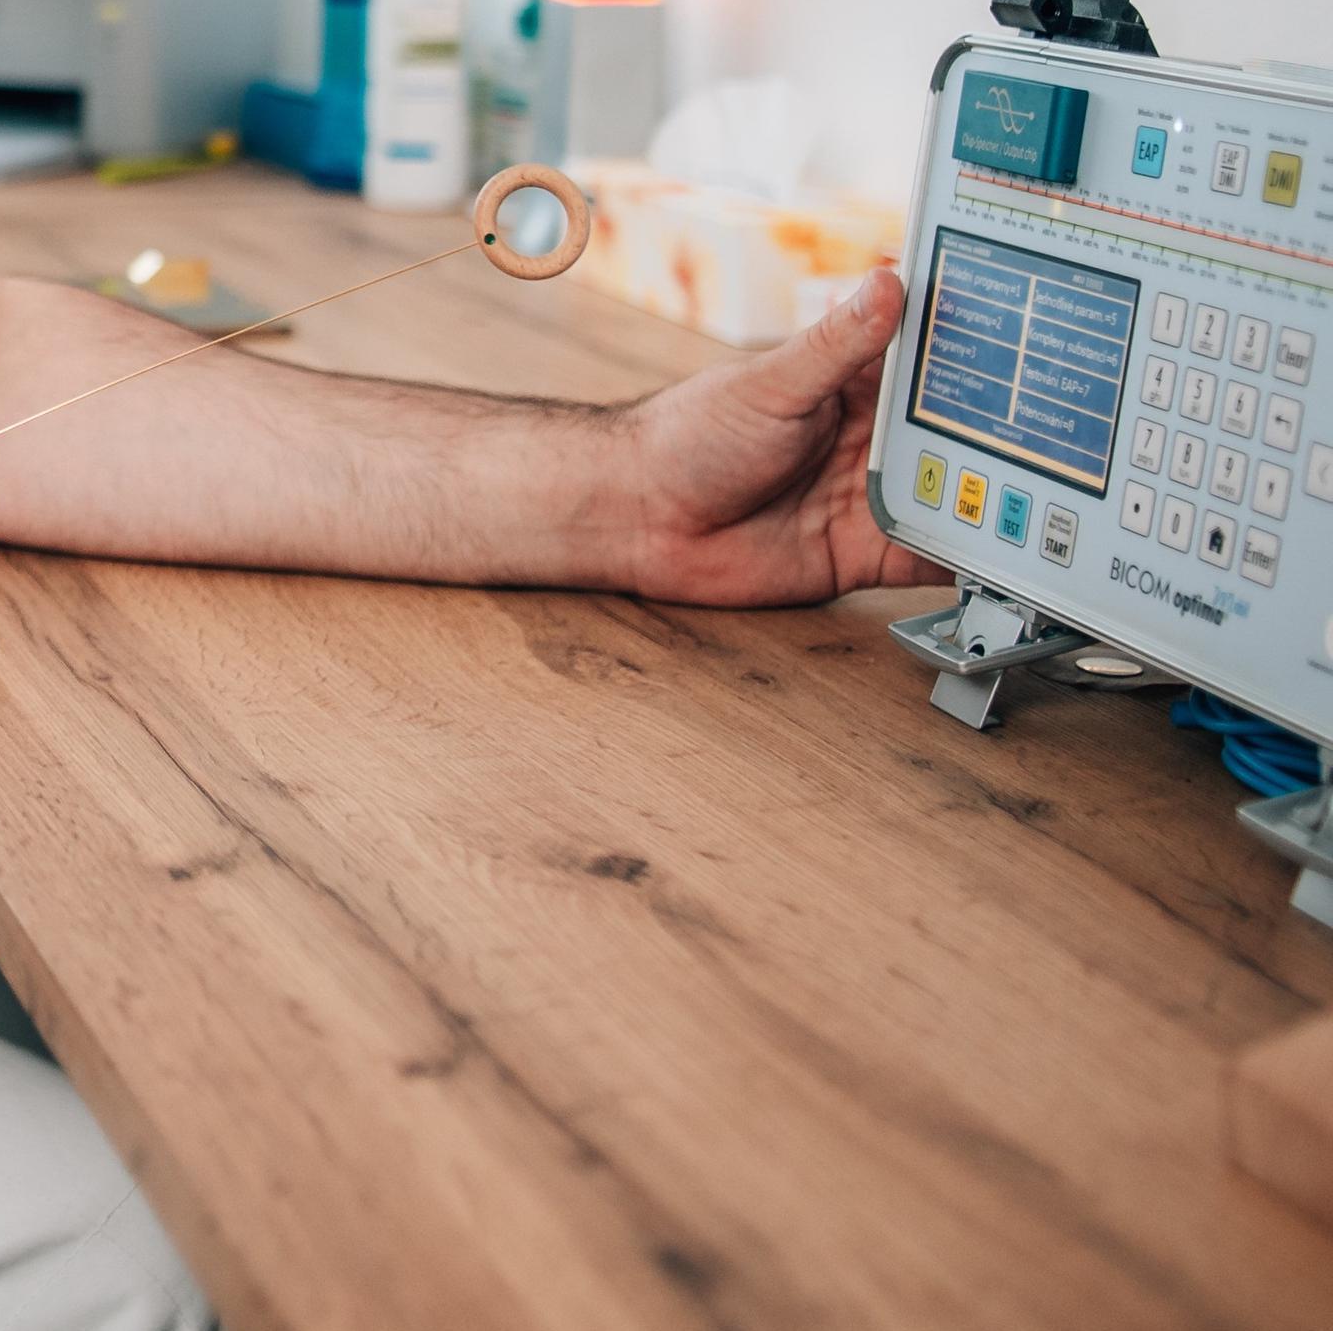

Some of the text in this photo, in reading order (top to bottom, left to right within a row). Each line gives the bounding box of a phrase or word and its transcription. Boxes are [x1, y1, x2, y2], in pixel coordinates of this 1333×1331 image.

[1138, 141, 1160, 162] EAP
[1221, 148, 1240, 165] EAP
[1166, 309, 1173, 331] 1
[1204, 313, 1215, 336] 2
[1245, 325, 1256, 348] 3
[1154, 366, 1164, 387] 4
[1193, 378, 1204, 400] 5
[1235, 391, 1245, 413] 6
[1144, 428, 1154, 449] 7
[1183, 442, 1193, 464] 8
[1225, 456, 1234, 479] 9
[958, 499, 980, 520] START
[1002, 518, 1021, 538] TEST
[1044, 537, 1069, 559] START
[1110, 556, 1171, 604] BICOM
